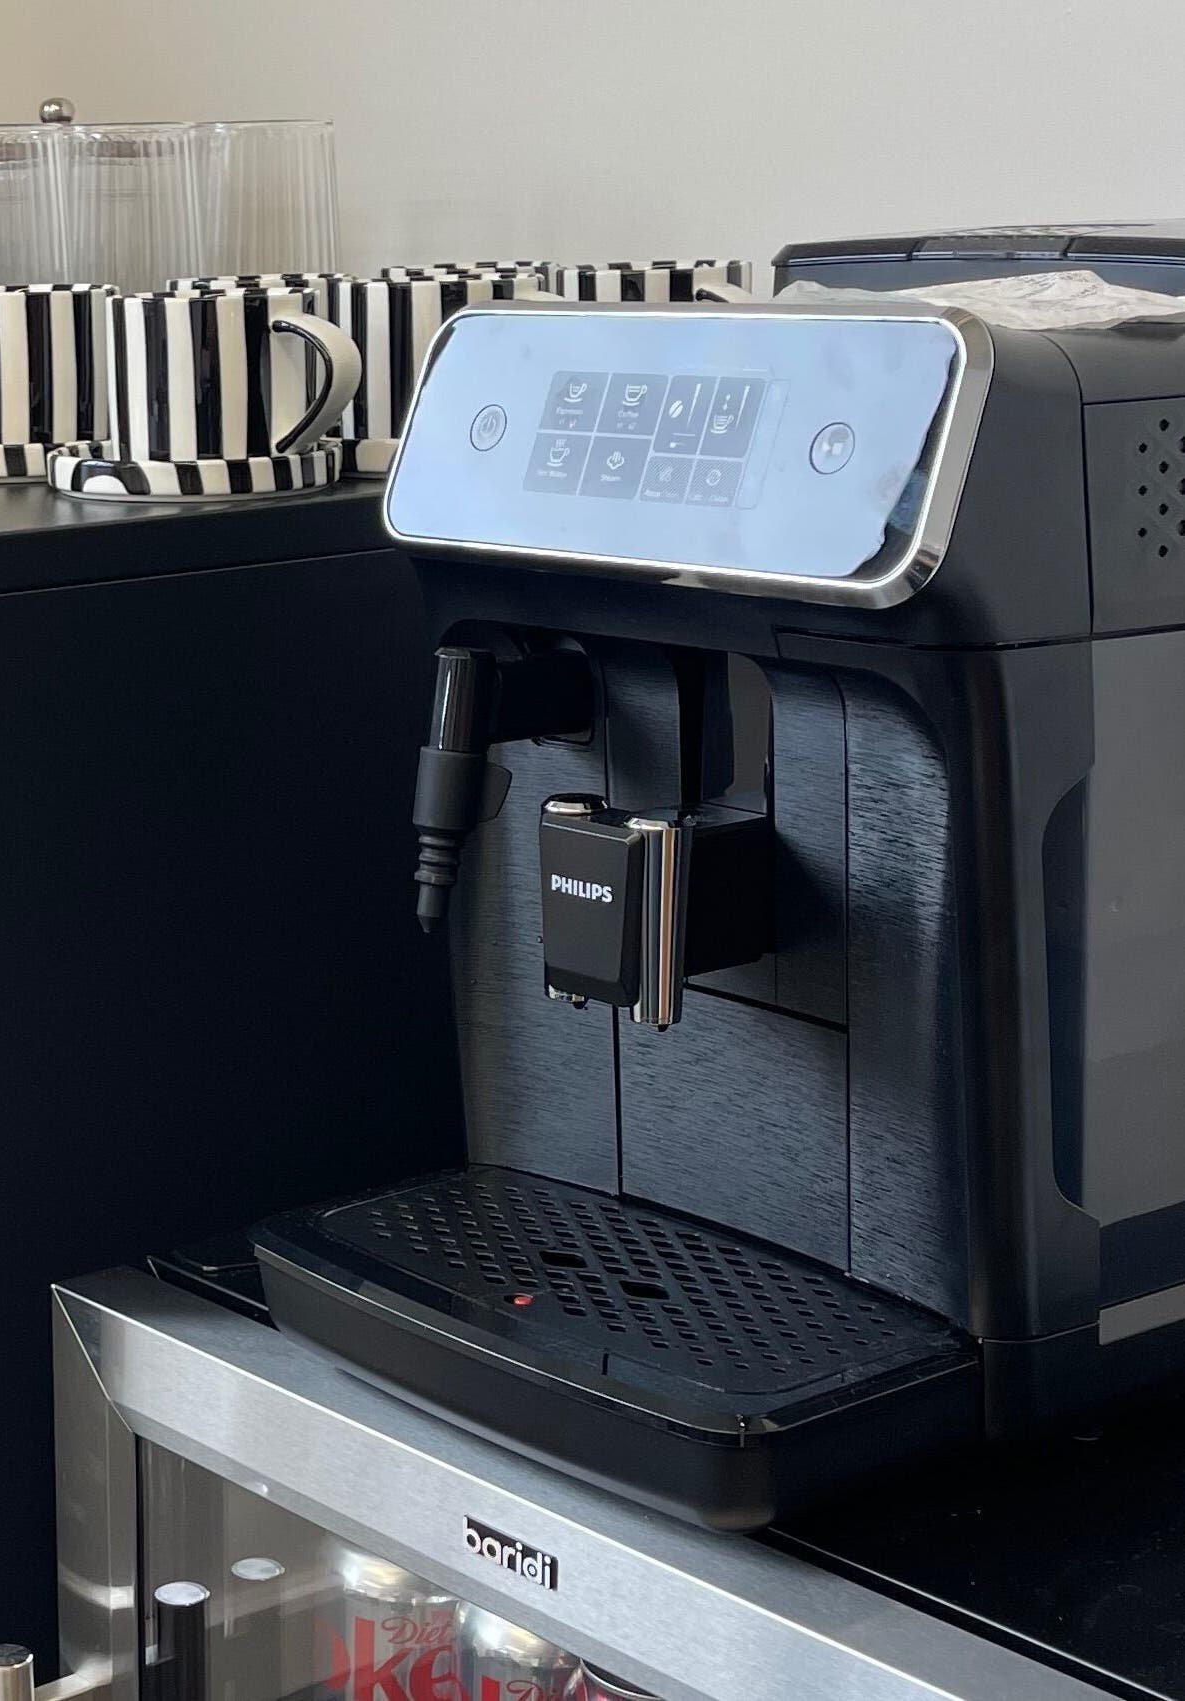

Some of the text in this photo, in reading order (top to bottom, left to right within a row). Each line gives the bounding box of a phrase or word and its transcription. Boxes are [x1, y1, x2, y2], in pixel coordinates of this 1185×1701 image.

[551, 874, 613, 903] PHILIPS
[462, 1515, 552, 1590] baridi
[381, 1616, 453, 1645] Diet
